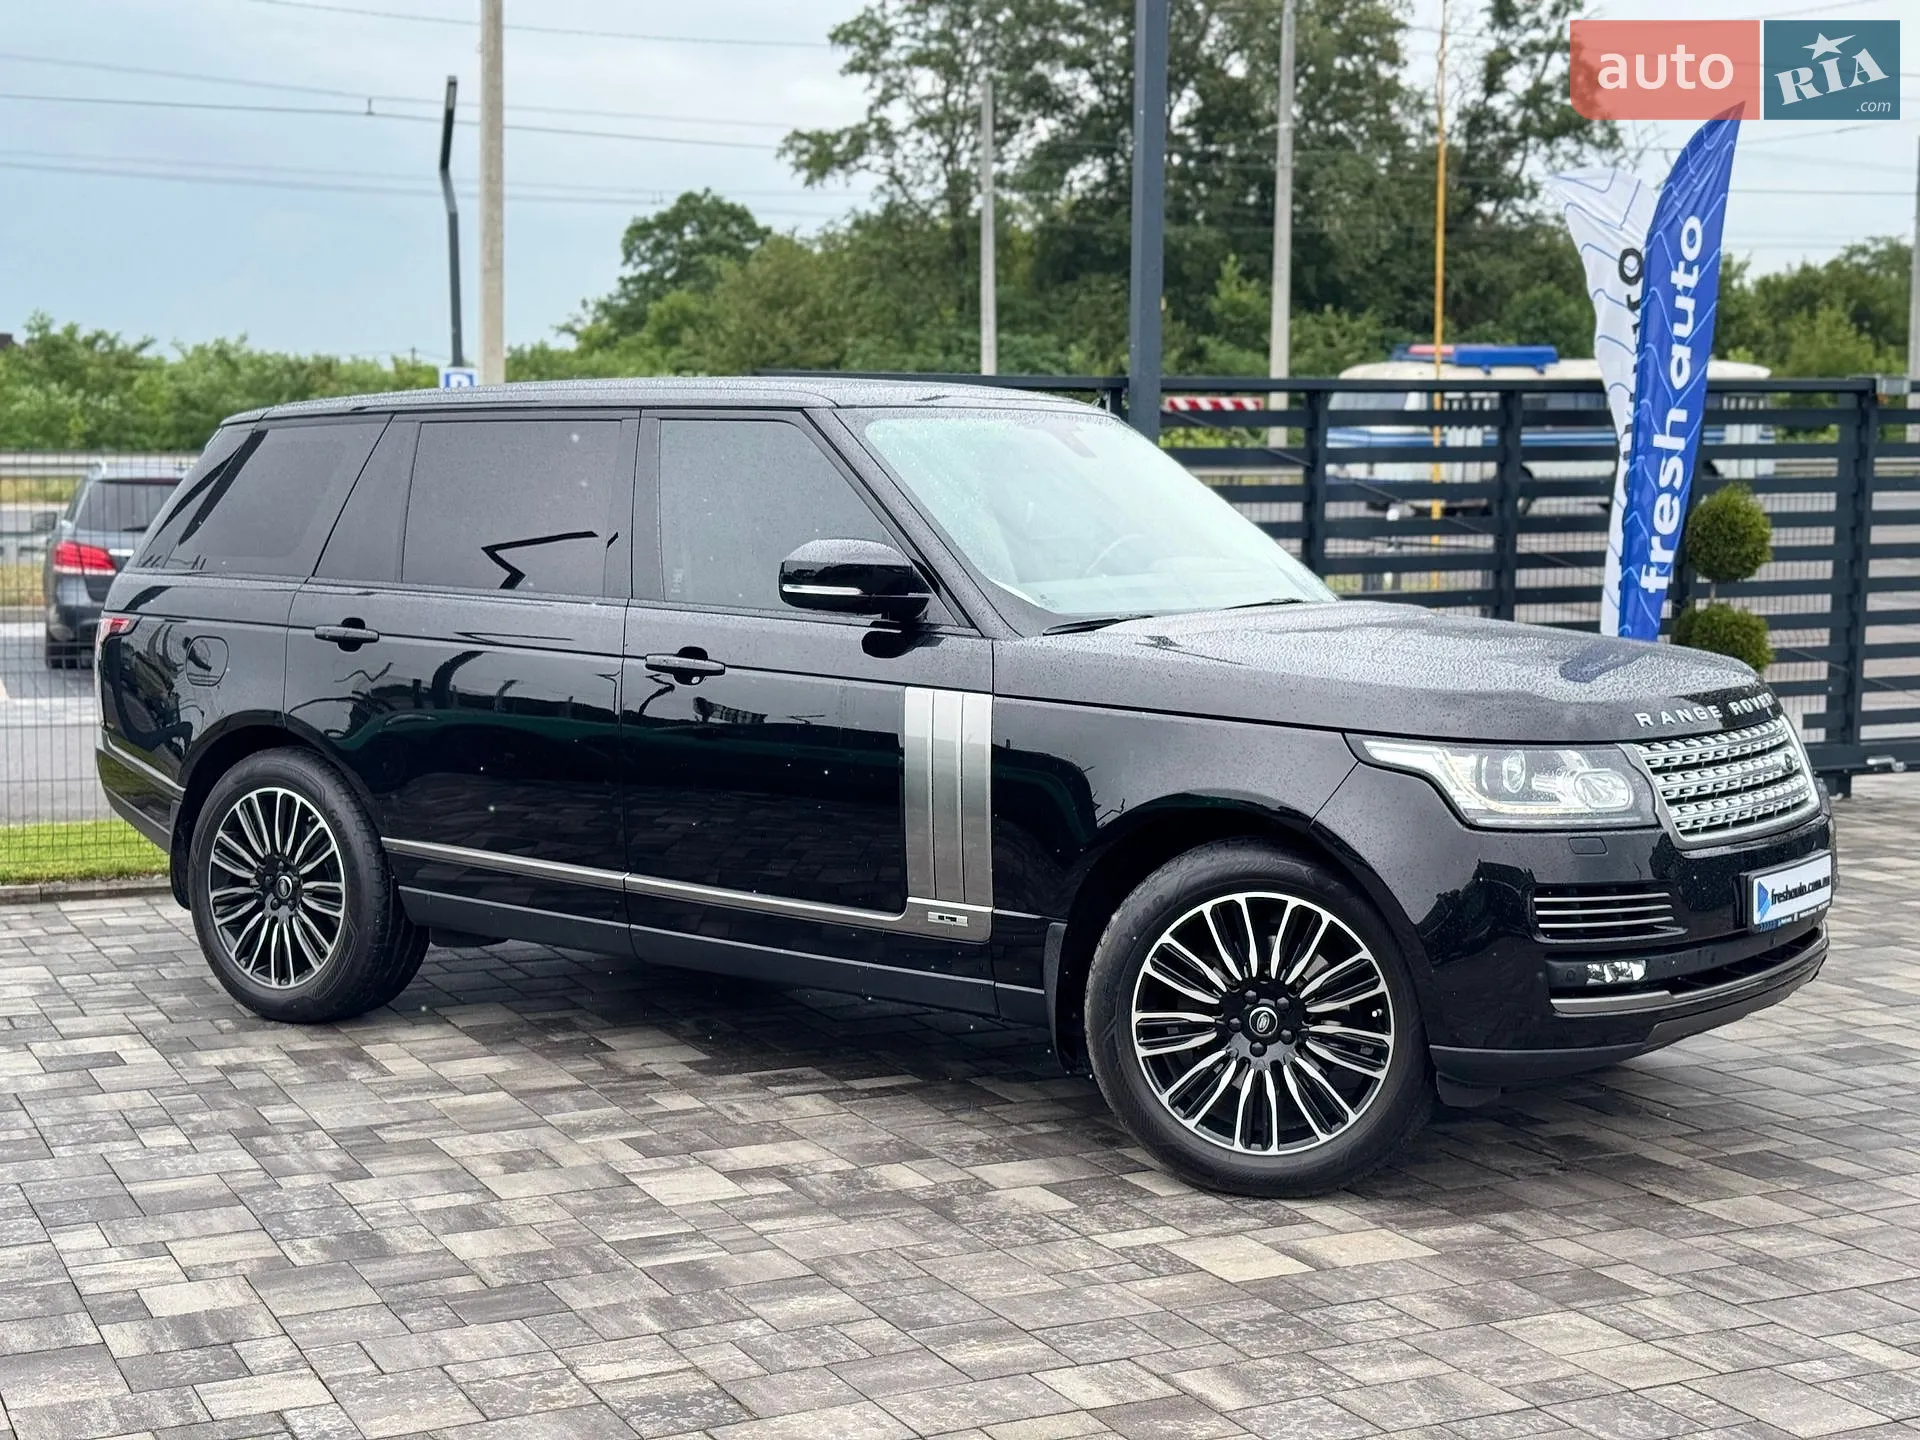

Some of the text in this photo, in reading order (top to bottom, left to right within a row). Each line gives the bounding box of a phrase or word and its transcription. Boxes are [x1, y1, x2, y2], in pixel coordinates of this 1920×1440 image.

[1640, 215, 1703, 594] fresh auto
[1634, 705, 1723, 728] RANGE
